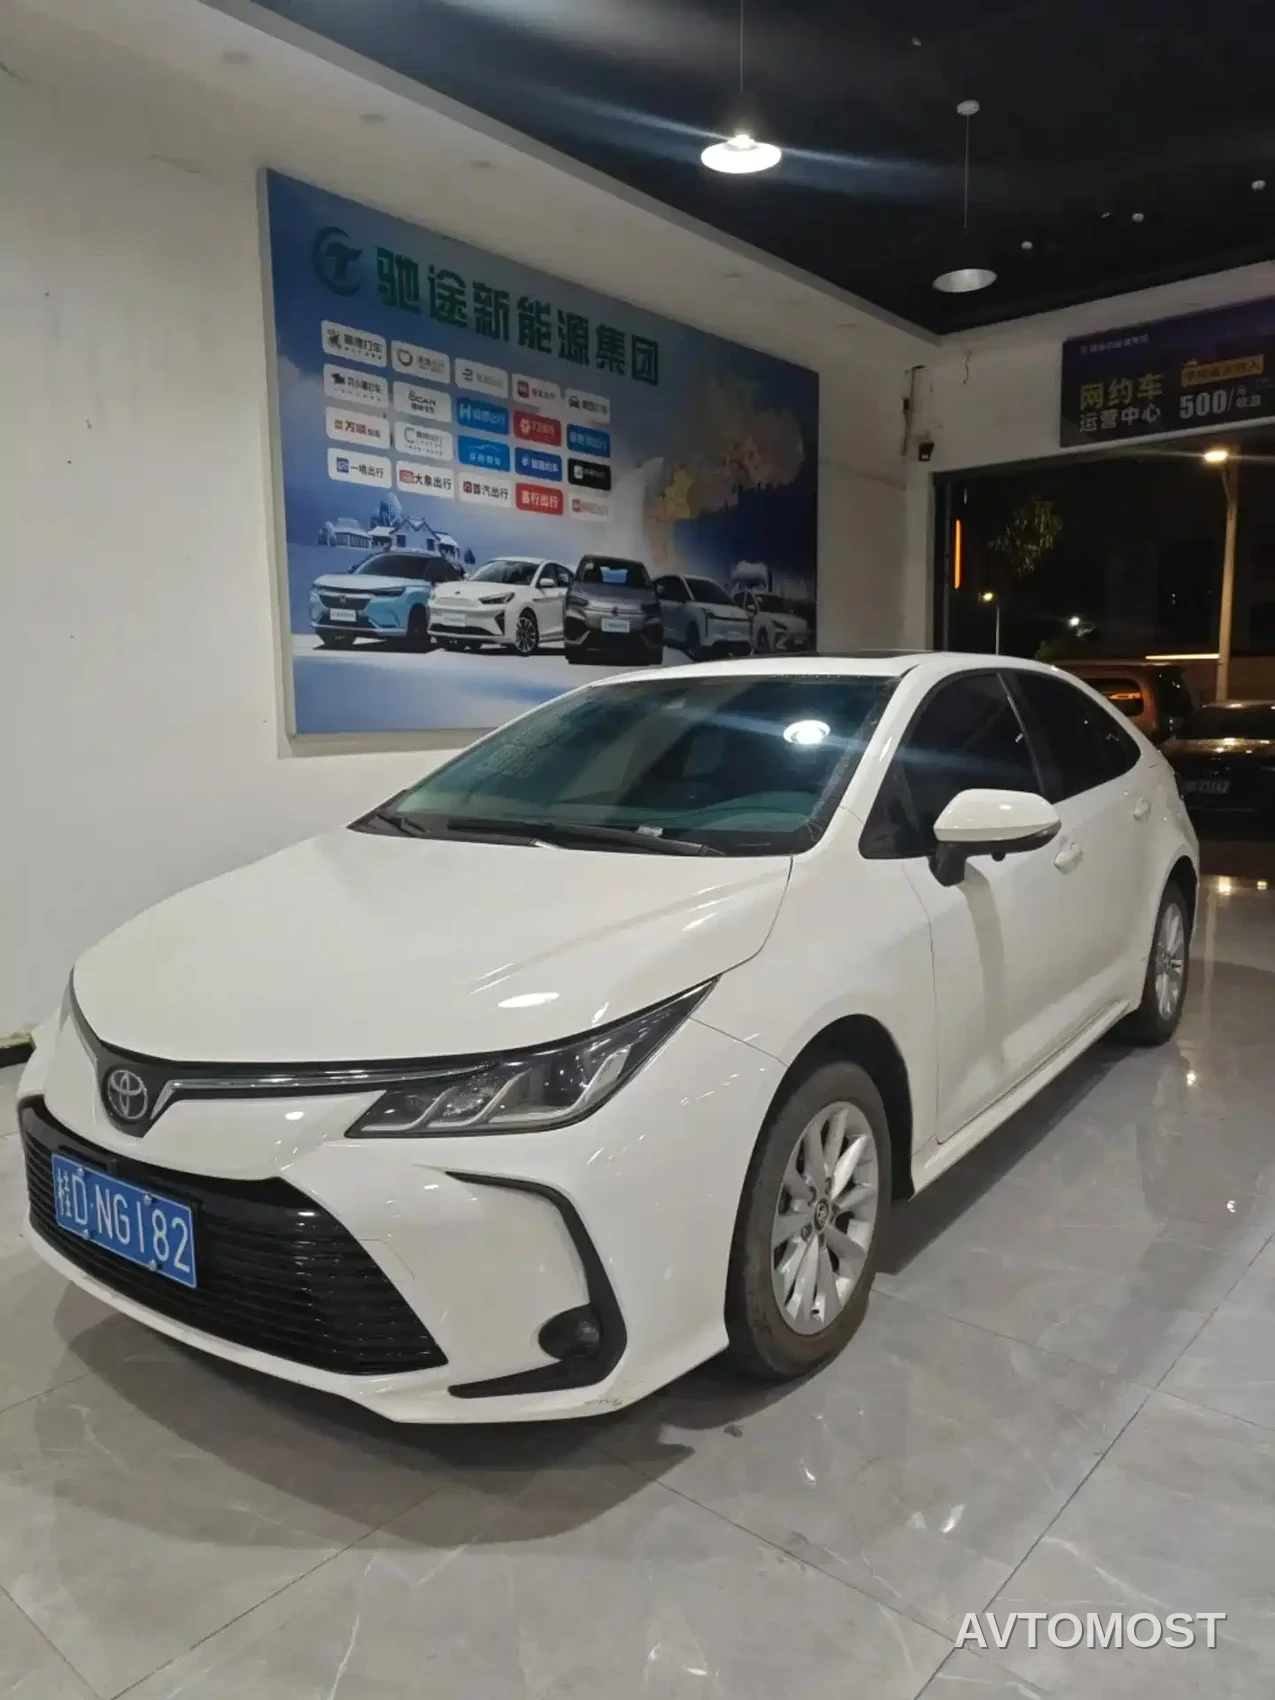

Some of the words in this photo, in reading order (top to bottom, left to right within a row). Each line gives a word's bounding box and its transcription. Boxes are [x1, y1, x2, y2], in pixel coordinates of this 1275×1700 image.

[376, 247, 660, 386] 驰途新能源集团
[1080, 373, 1163, 410] 网约车
[1079, 403, 1161, 432] 运营中心
[414, 472, 452, 491] 大象出行
